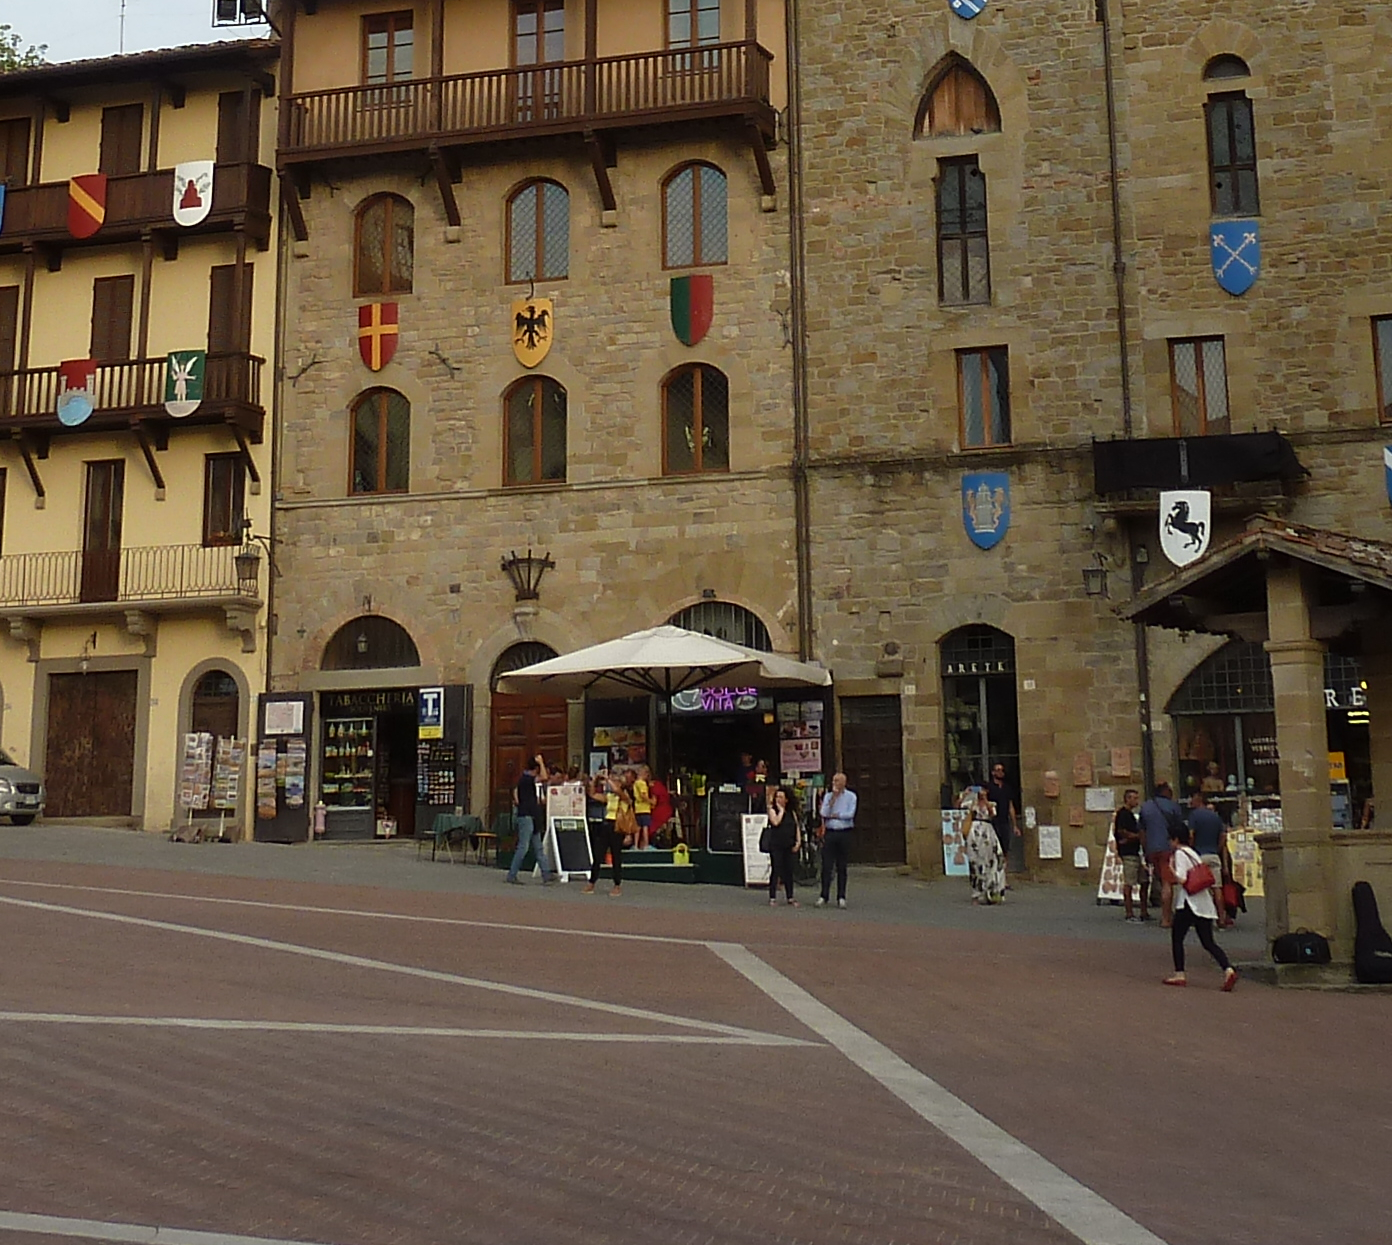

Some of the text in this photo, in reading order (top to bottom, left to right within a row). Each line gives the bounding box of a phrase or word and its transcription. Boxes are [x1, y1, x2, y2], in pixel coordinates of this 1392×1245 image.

[328, 691, 414, 707] TABACCHERIA
[700, 686, 758, 696] DOLCE
[701, 695, 734, 711] VITA
